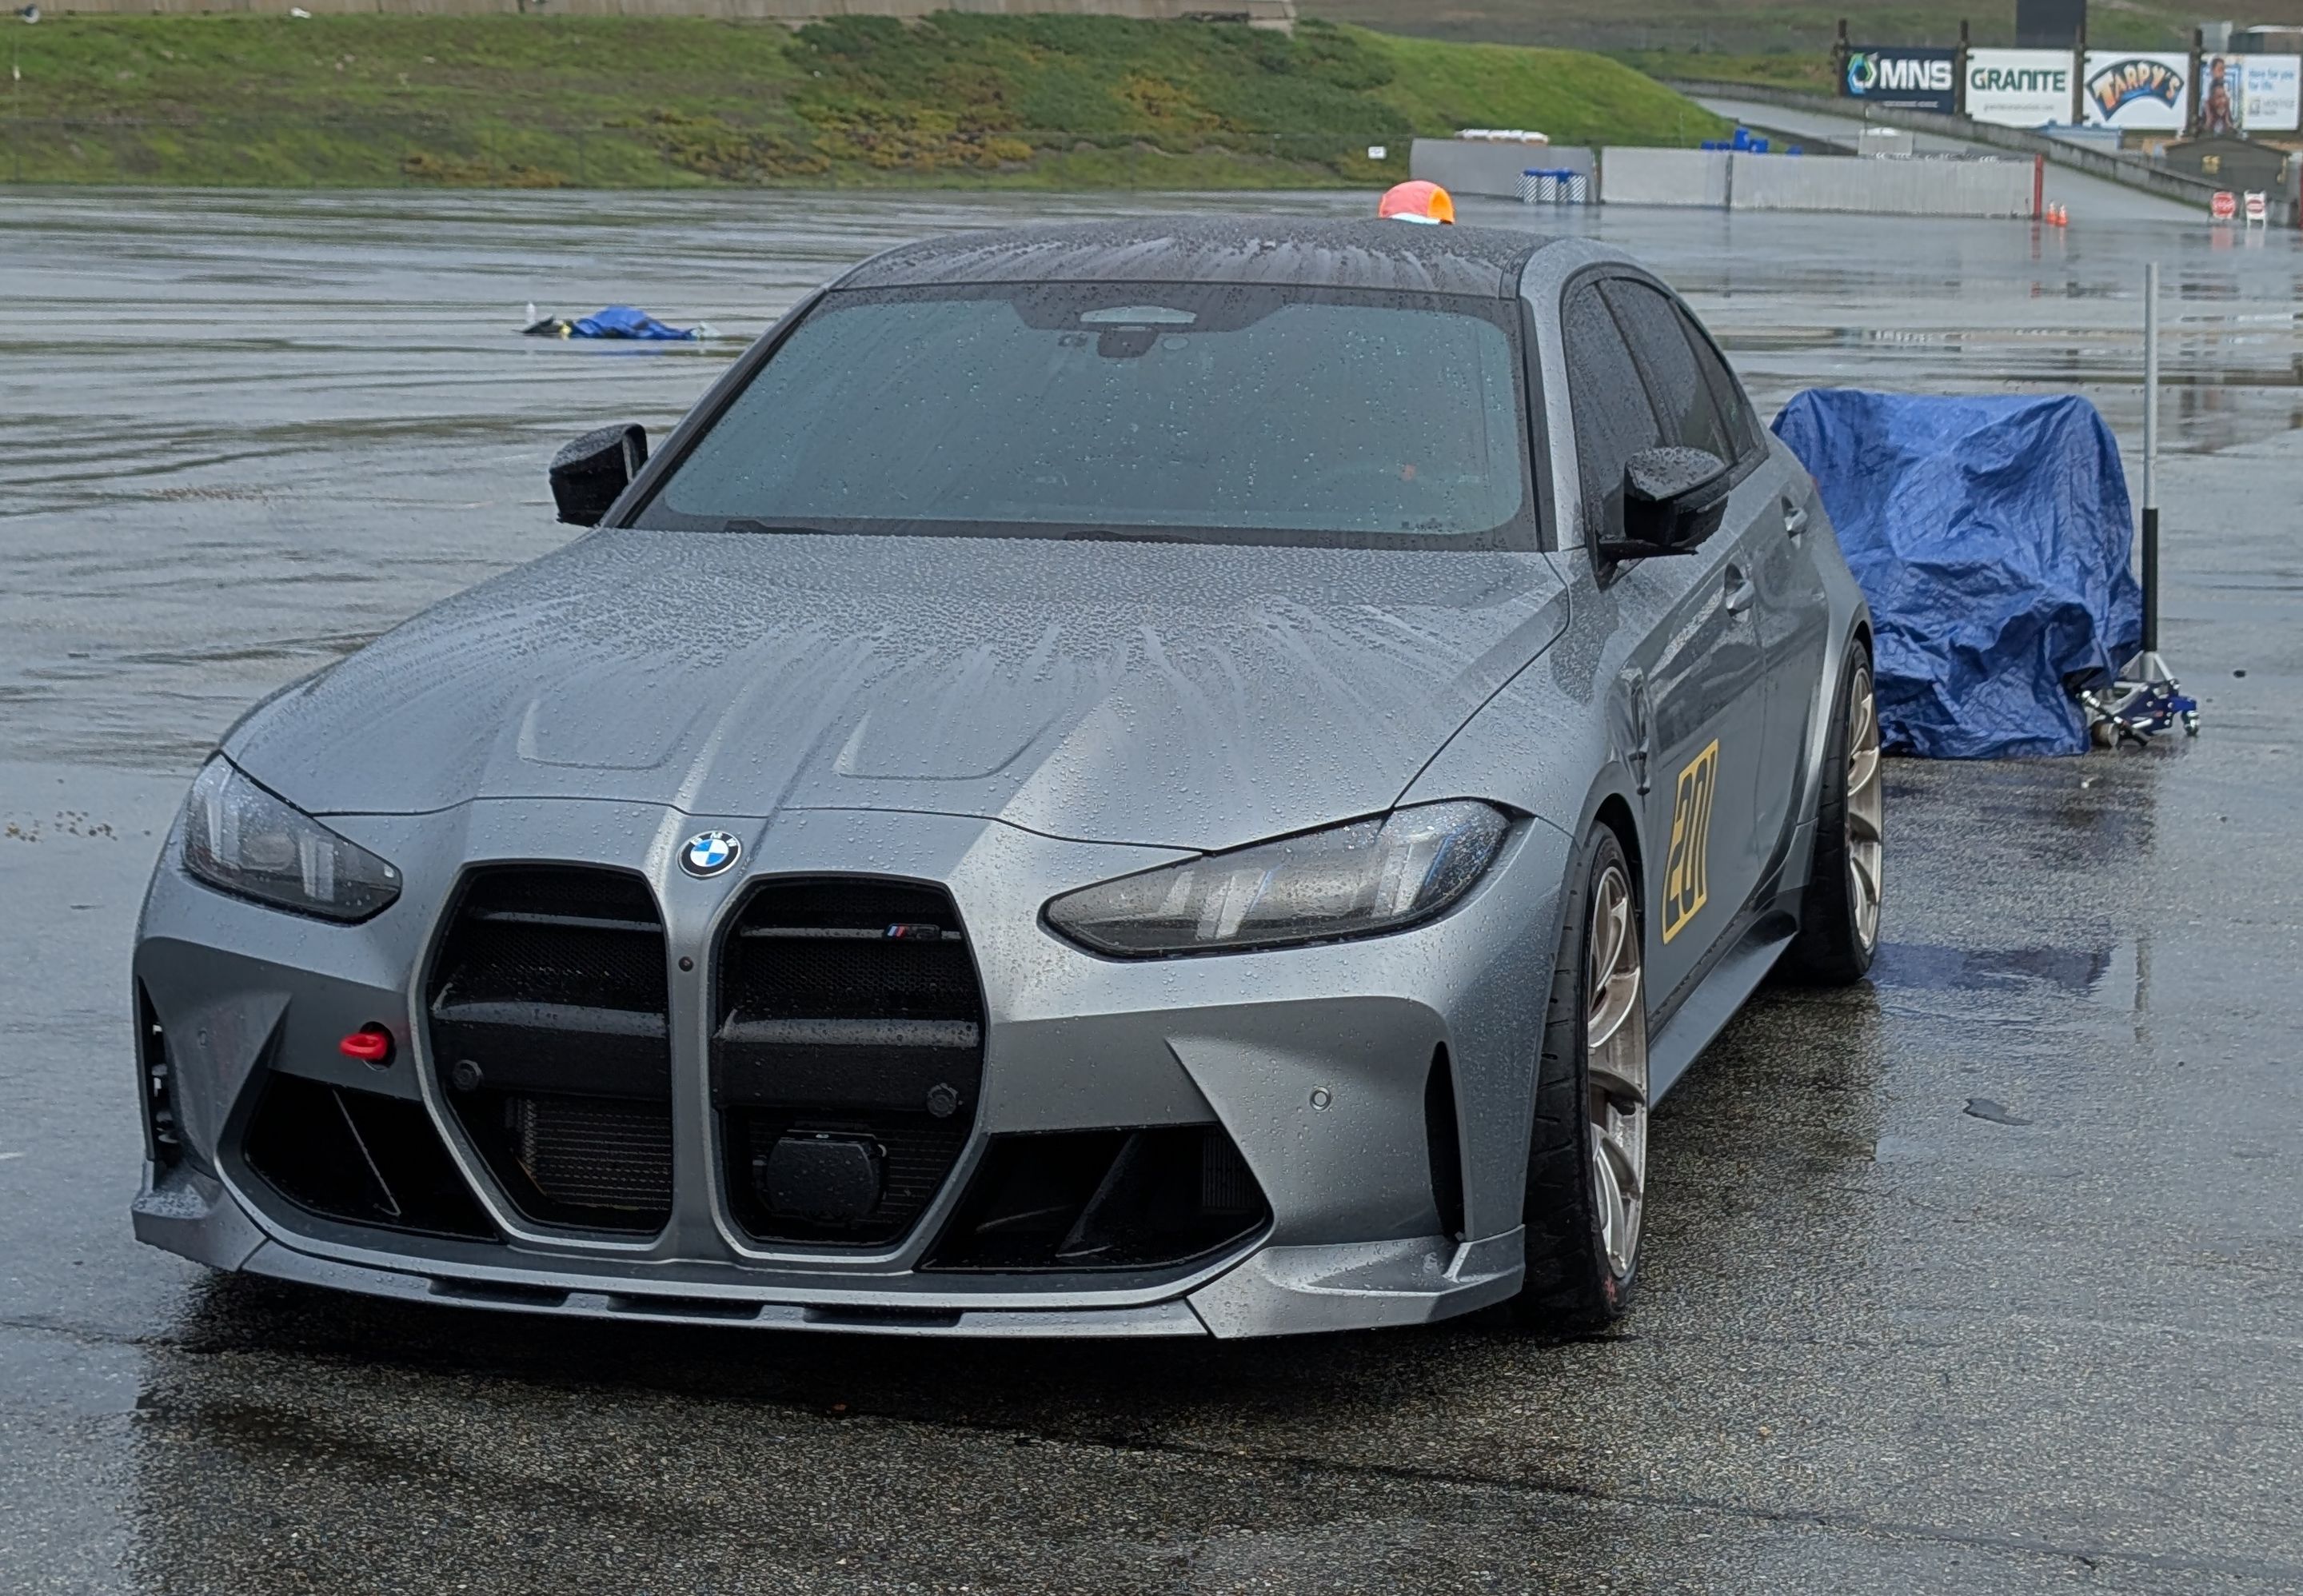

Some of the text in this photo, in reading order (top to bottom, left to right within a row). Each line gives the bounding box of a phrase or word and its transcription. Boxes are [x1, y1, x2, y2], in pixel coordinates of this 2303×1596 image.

[1879, 58, 1952, 90] MNS
[1970, 67, 2066, 92] GRANITE
[2091, 62, 2181, 110] TARPY'S
[690, 832, 737, 848] BMW
